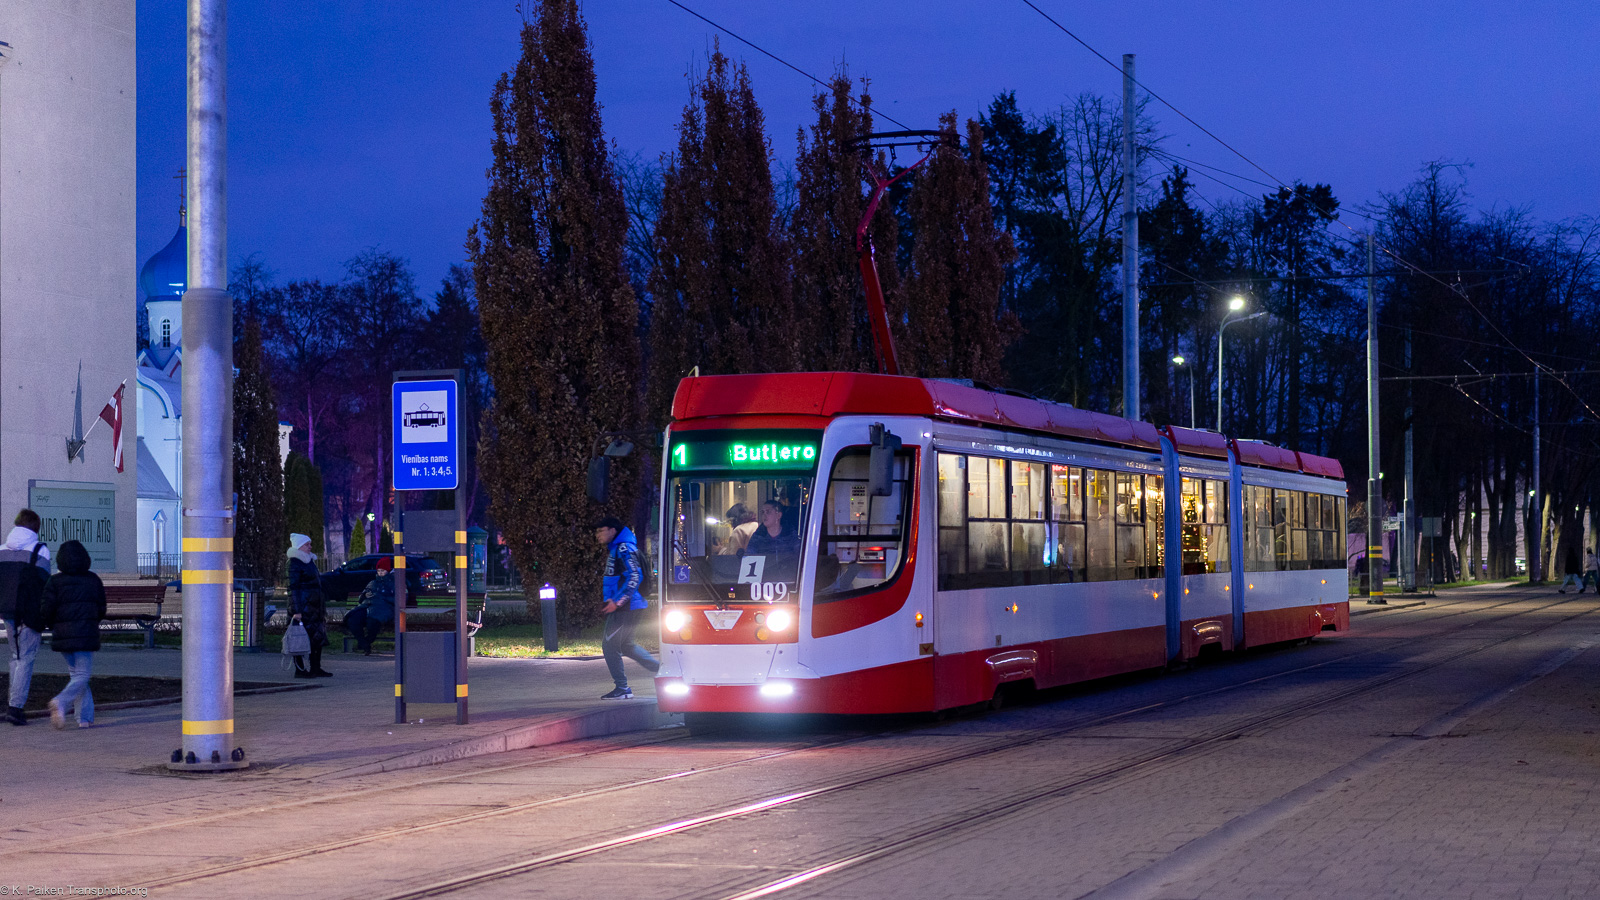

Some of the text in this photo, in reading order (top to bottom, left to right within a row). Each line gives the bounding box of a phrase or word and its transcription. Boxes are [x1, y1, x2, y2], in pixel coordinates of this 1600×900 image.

[401, 454, 448, 464] Vienības nams
[674, 443, 686, 465] 1
[411, 467, 421, 477] Nr.
[97, 516, 111, 543] ATĪS
[745, 560, 758, 578] 1
[750, 581, 788, 601] 009
